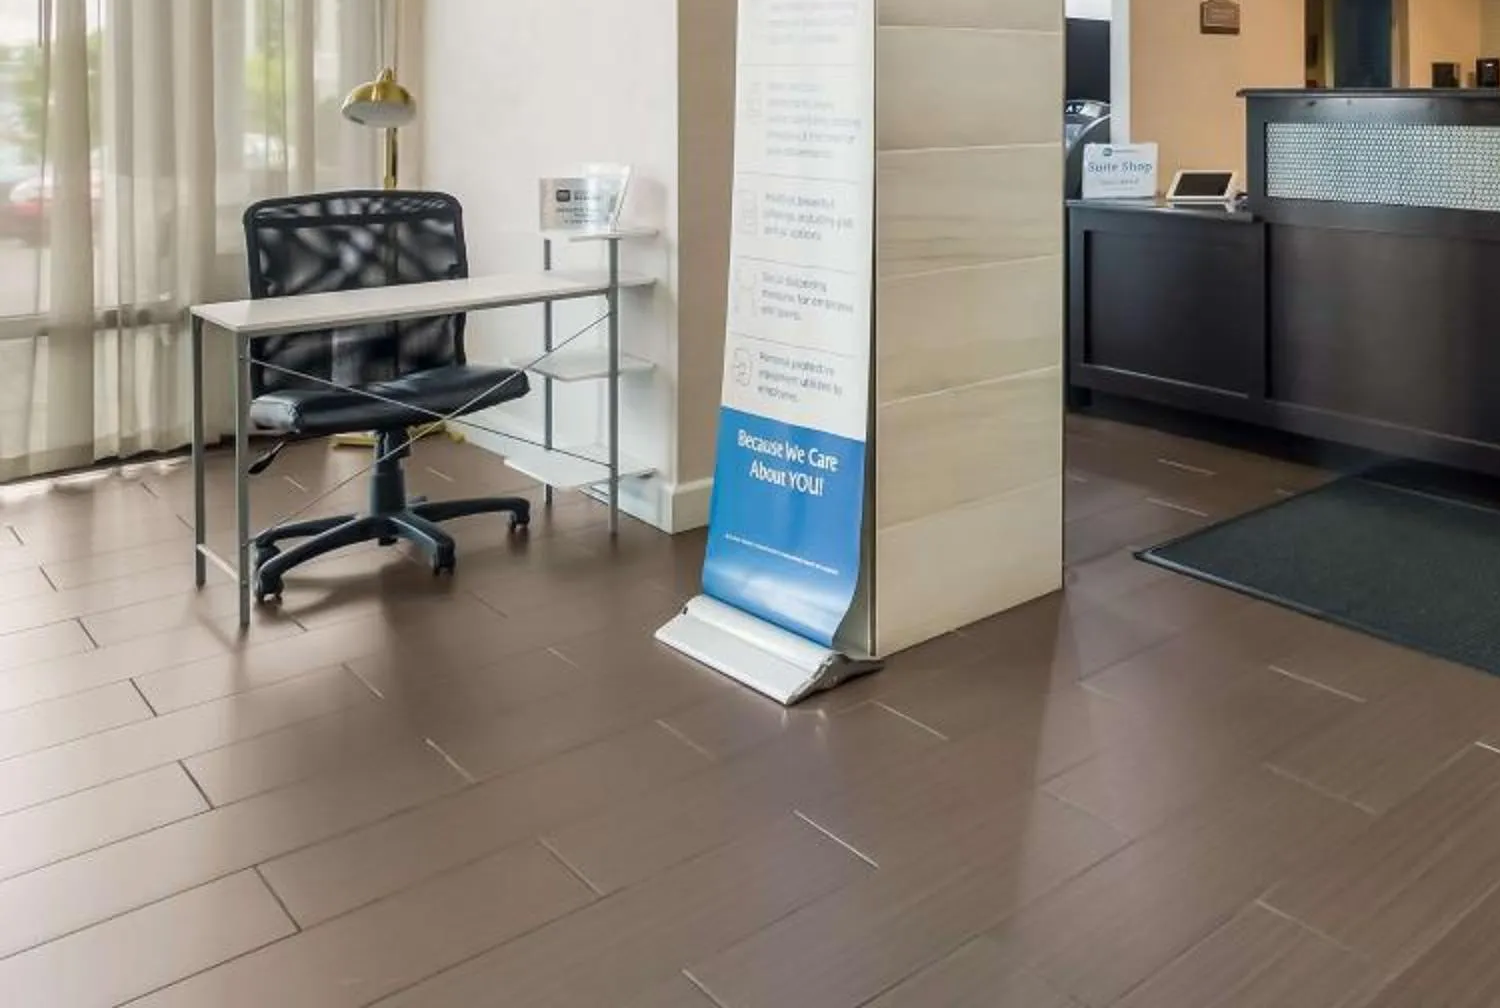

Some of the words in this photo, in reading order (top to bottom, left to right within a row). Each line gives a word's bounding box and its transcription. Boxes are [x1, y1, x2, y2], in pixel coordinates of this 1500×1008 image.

[1121, 160, 1153, 174] Shop
[737, 429, 783, 458] Because
[785, 440, 806, 464] We
[808, 447, 839, 472] Care
[749, 459, 786, 486] About
[788, 471, 824, 496] YOU!
